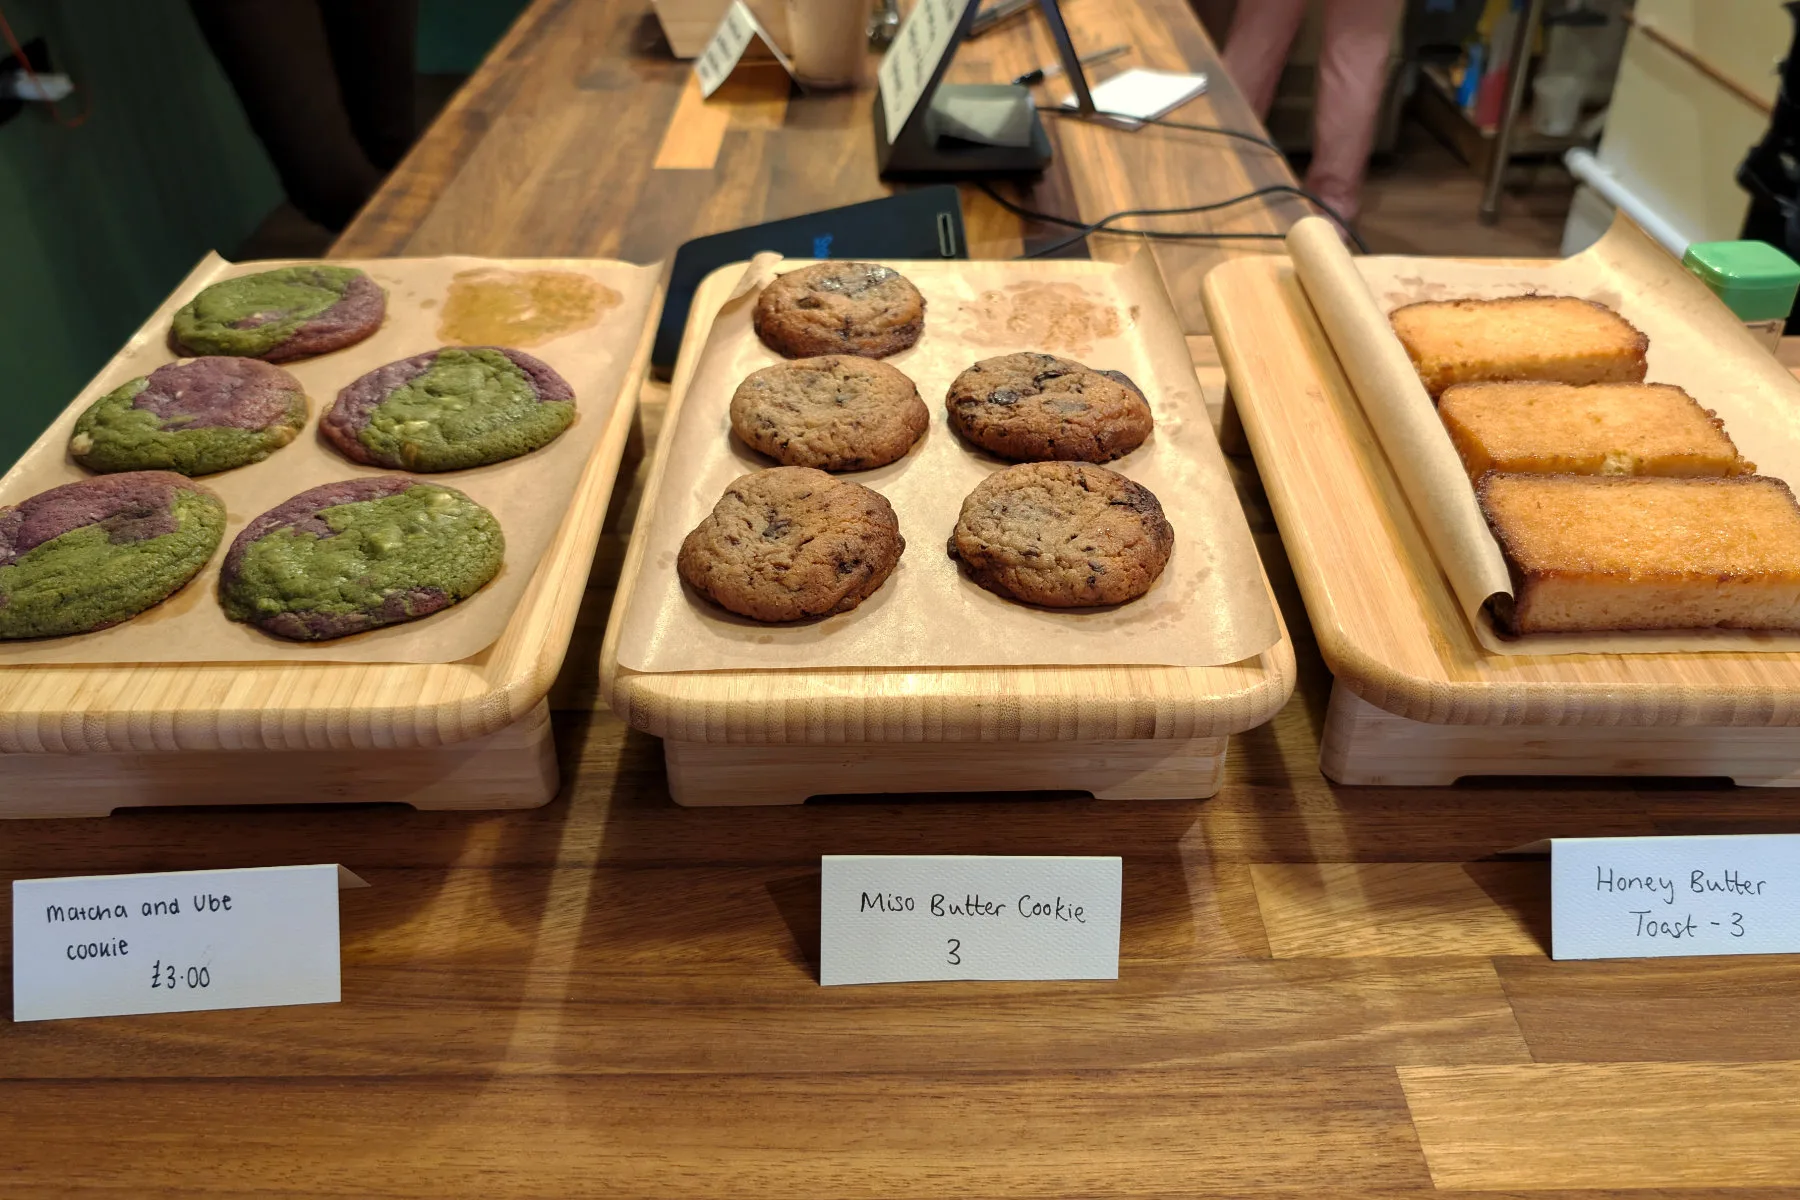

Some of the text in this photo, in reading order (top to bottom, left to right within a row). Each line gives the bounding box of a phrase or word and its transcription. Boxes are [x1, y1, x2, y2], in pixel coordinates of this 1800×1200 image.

[1596, 865, 1767, 905] Honey Butter
[141, 897, 181, 917] and
[193, 893, 233, 913] Ube
[860, 892, 1087, 924] Miso Butter Cookie
[1628, 909, 1698, 939] Toast
[946, 938, 962, 966] 3
